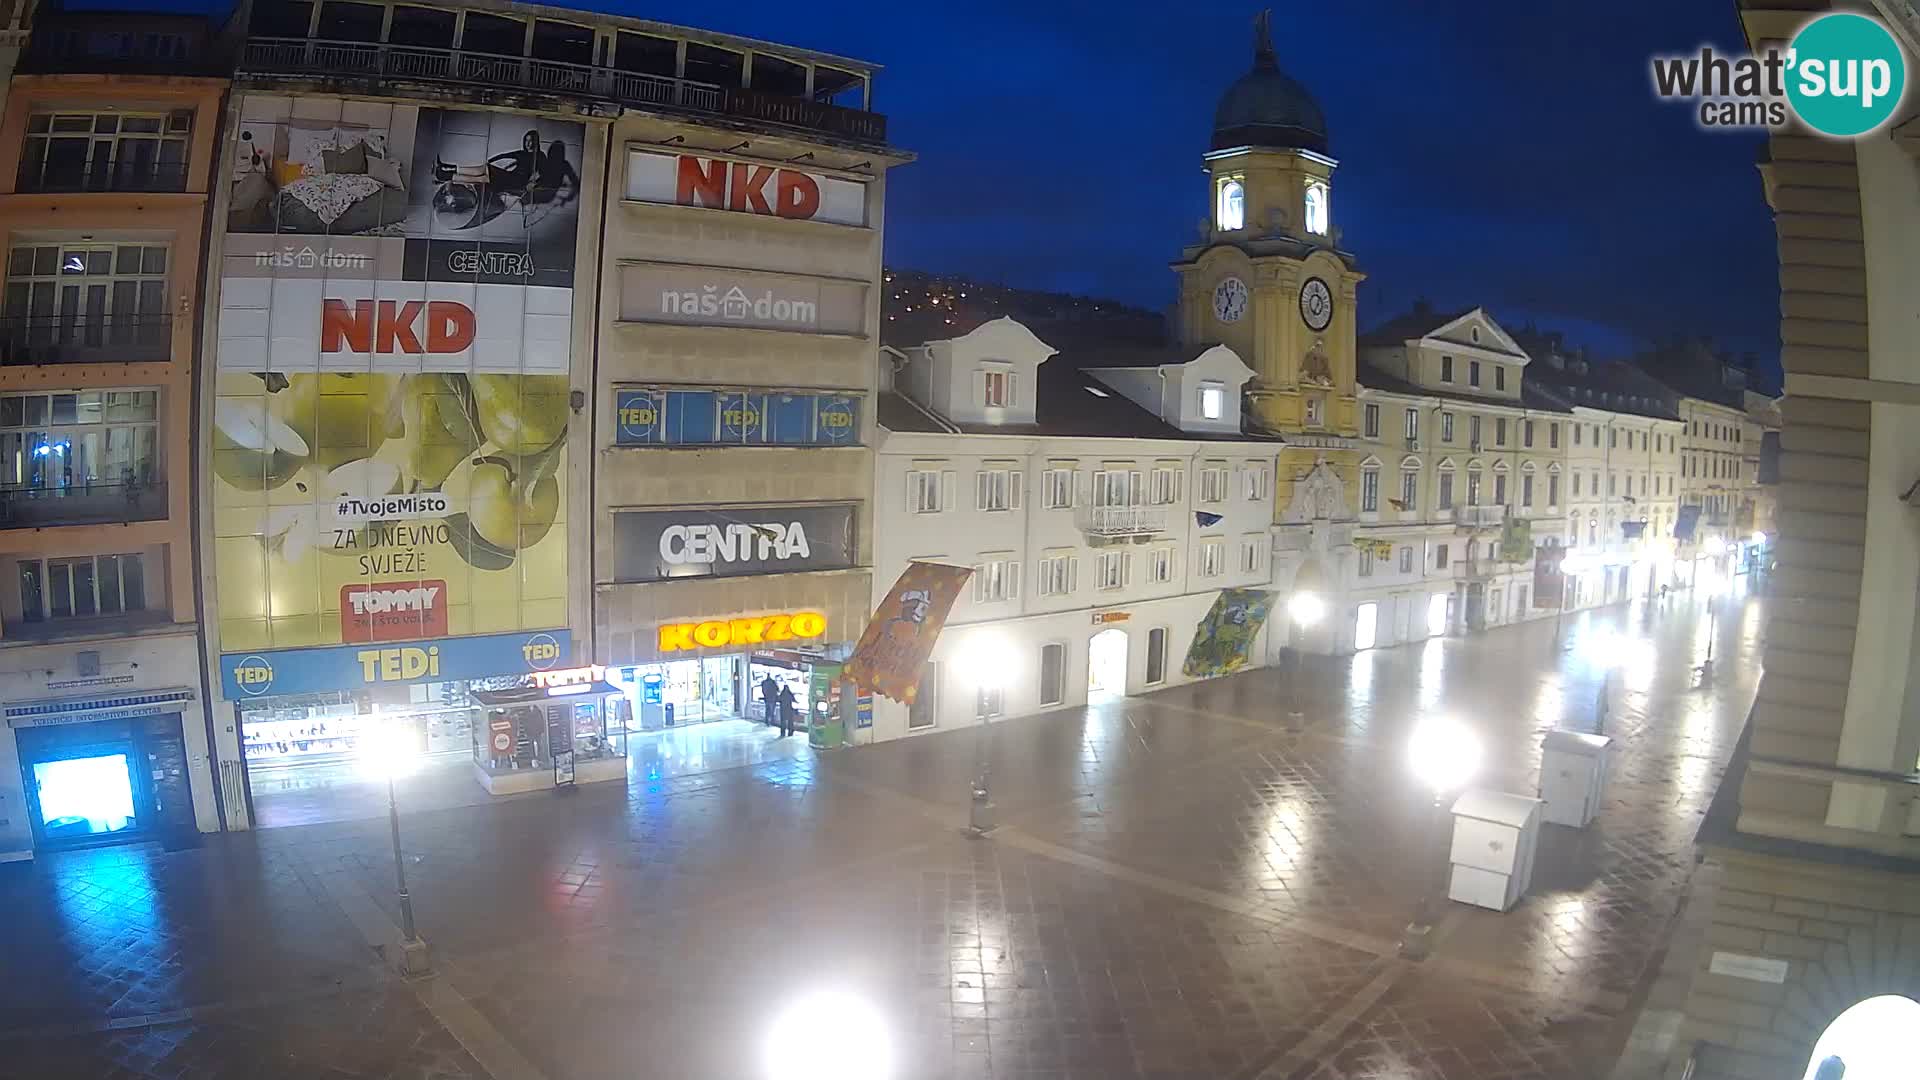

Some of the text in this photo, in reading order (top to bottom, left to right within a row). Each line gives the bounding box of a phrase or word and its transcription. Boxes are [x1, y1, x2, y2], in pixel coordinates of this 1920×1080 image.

[676, 155, 820, 220] NKD
[448, 250, 535, 276] CENTRA
[320, 299, 477, 354] NKD
[619, 408, 658, 425] TEDi
[723, 410, 760, 427] TEDi
[820, 411, 852, 427] TEDi
[338, 497, 447, 518] #TvojeMisto
[333, 524, 450, 550] ZA DNEVNO
[659, 521, 810, 564] CENTRA
[359, 549, 427, 576] SVJEŽE
[348, 587, 440, 615] TOMMY
[658, 612, 827, 652] KORZO
[358, 646, 441, 682] TEDi
[522, 643, 560, 661] TEDi
[234, 666, 274, 684] TEDi
